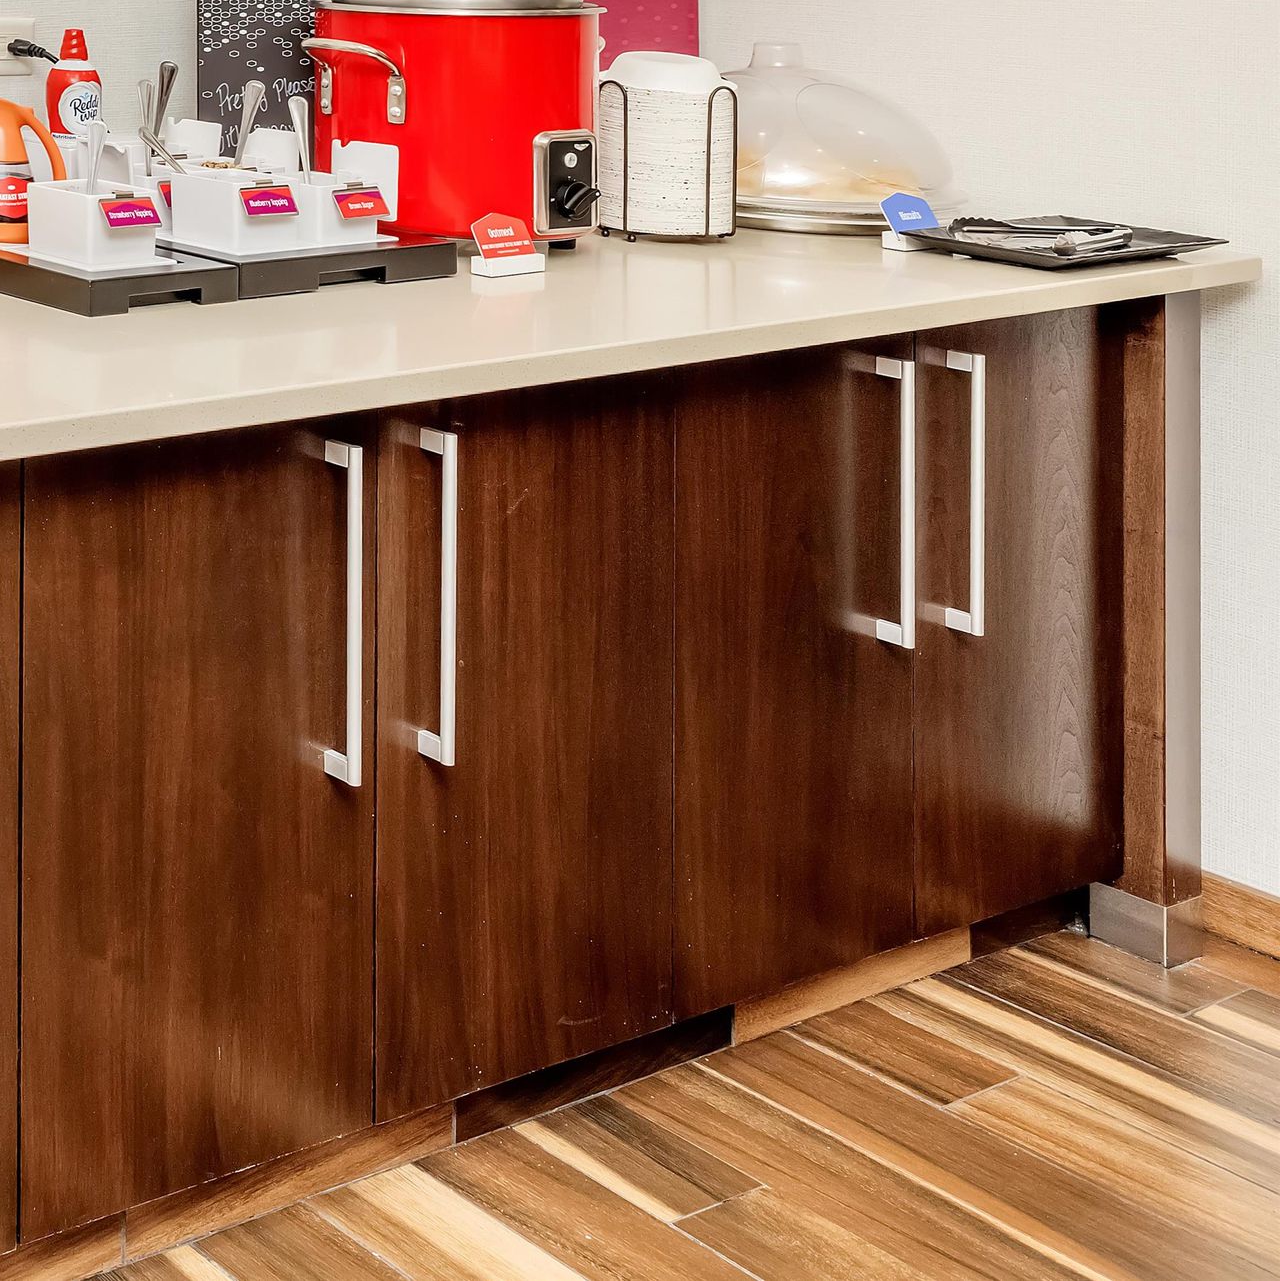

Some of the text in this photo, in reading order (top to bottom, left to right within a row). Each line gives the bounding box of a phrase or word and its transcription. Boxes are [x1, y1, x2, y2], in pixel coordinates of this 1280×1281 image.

[69, 94, 99, 121] Reddi wip
[216, 80, 269, 117] Prety
